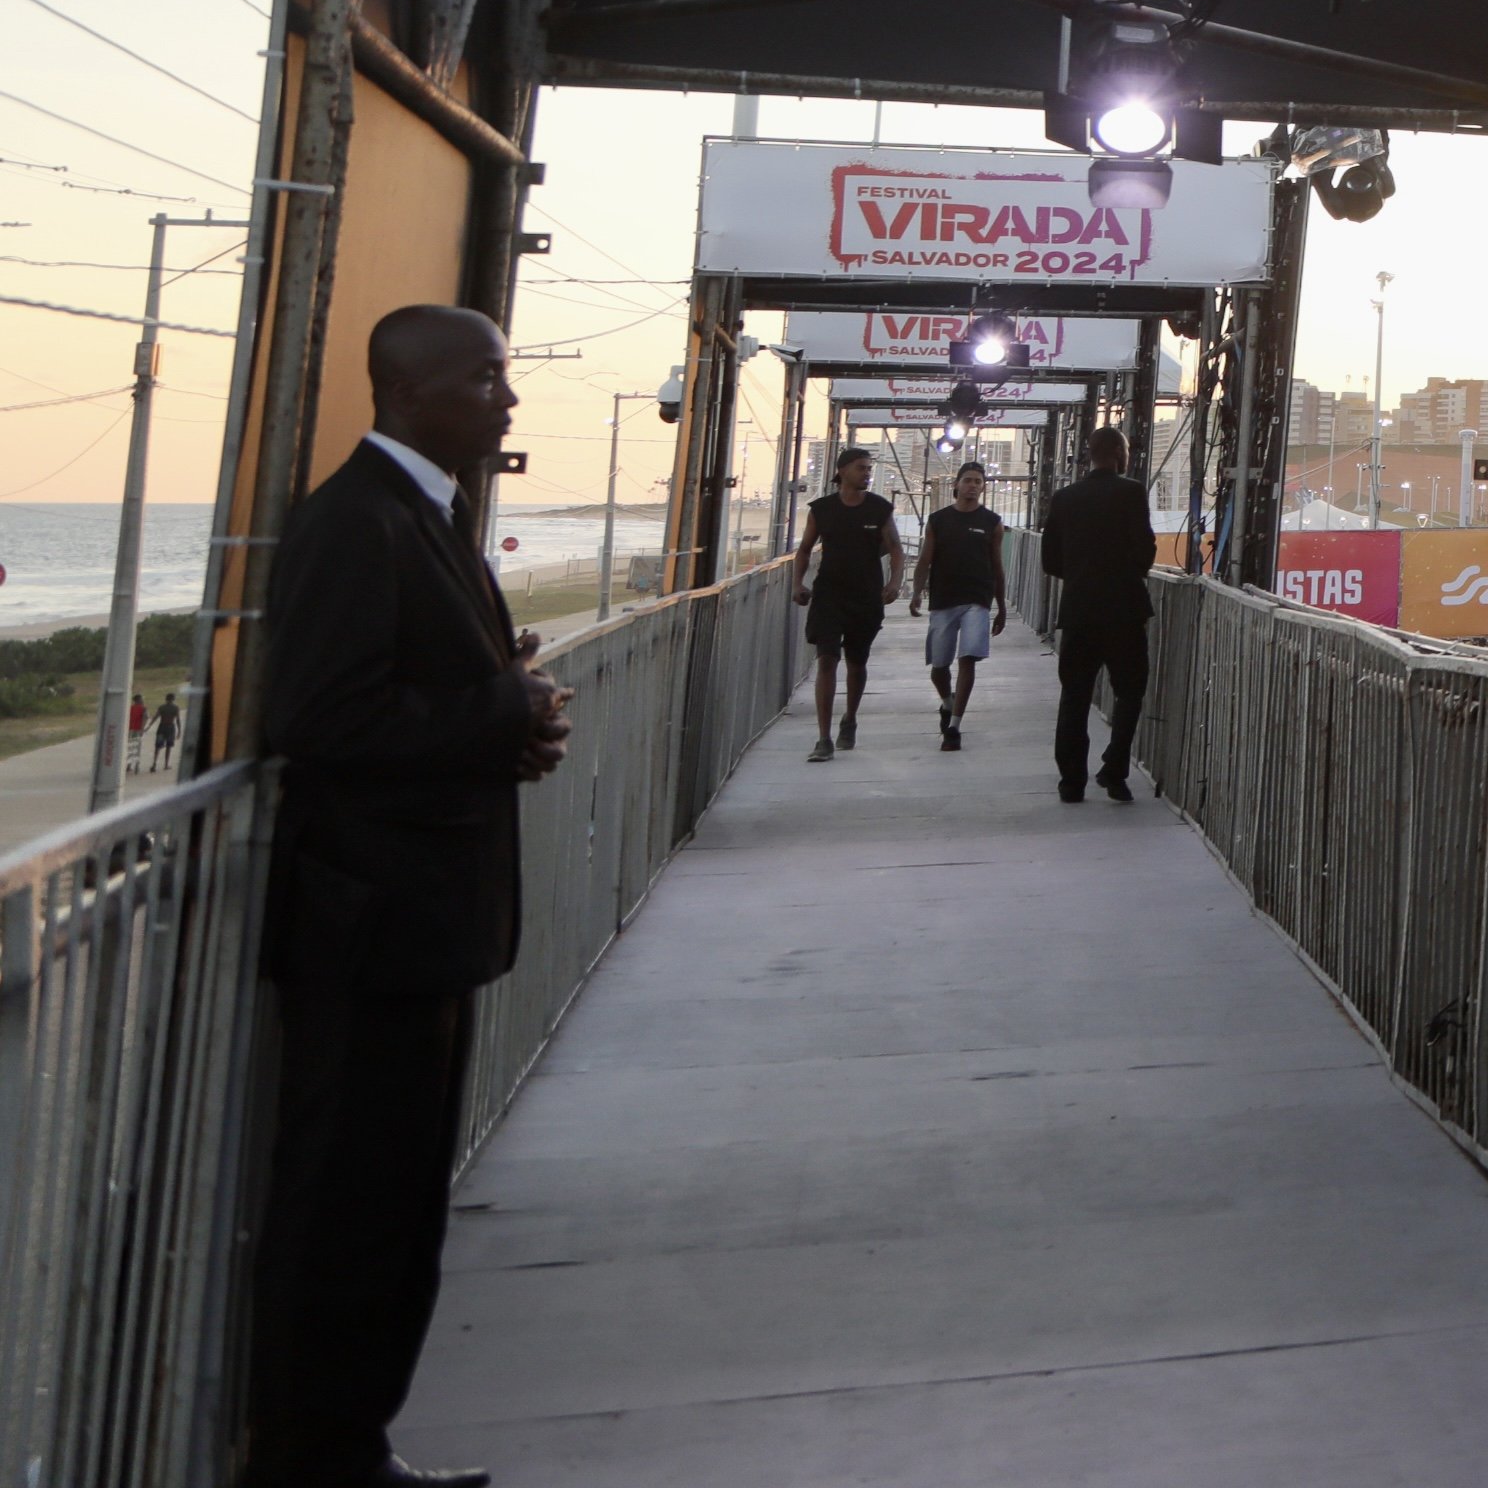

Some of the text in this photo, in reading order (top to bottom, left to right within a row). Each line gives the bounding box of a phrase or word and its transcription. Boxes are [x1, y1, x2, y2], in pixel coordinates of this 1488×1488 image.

[857, 186, 952, 200] FESTIVAL
[858, 201, 1130, 245] VIRADA
[871, 250, 1127, 274] SALVADOR 2024
[881, 315, 1049, 344] VIRA
[888, 345, 950, 356] SALVAD
